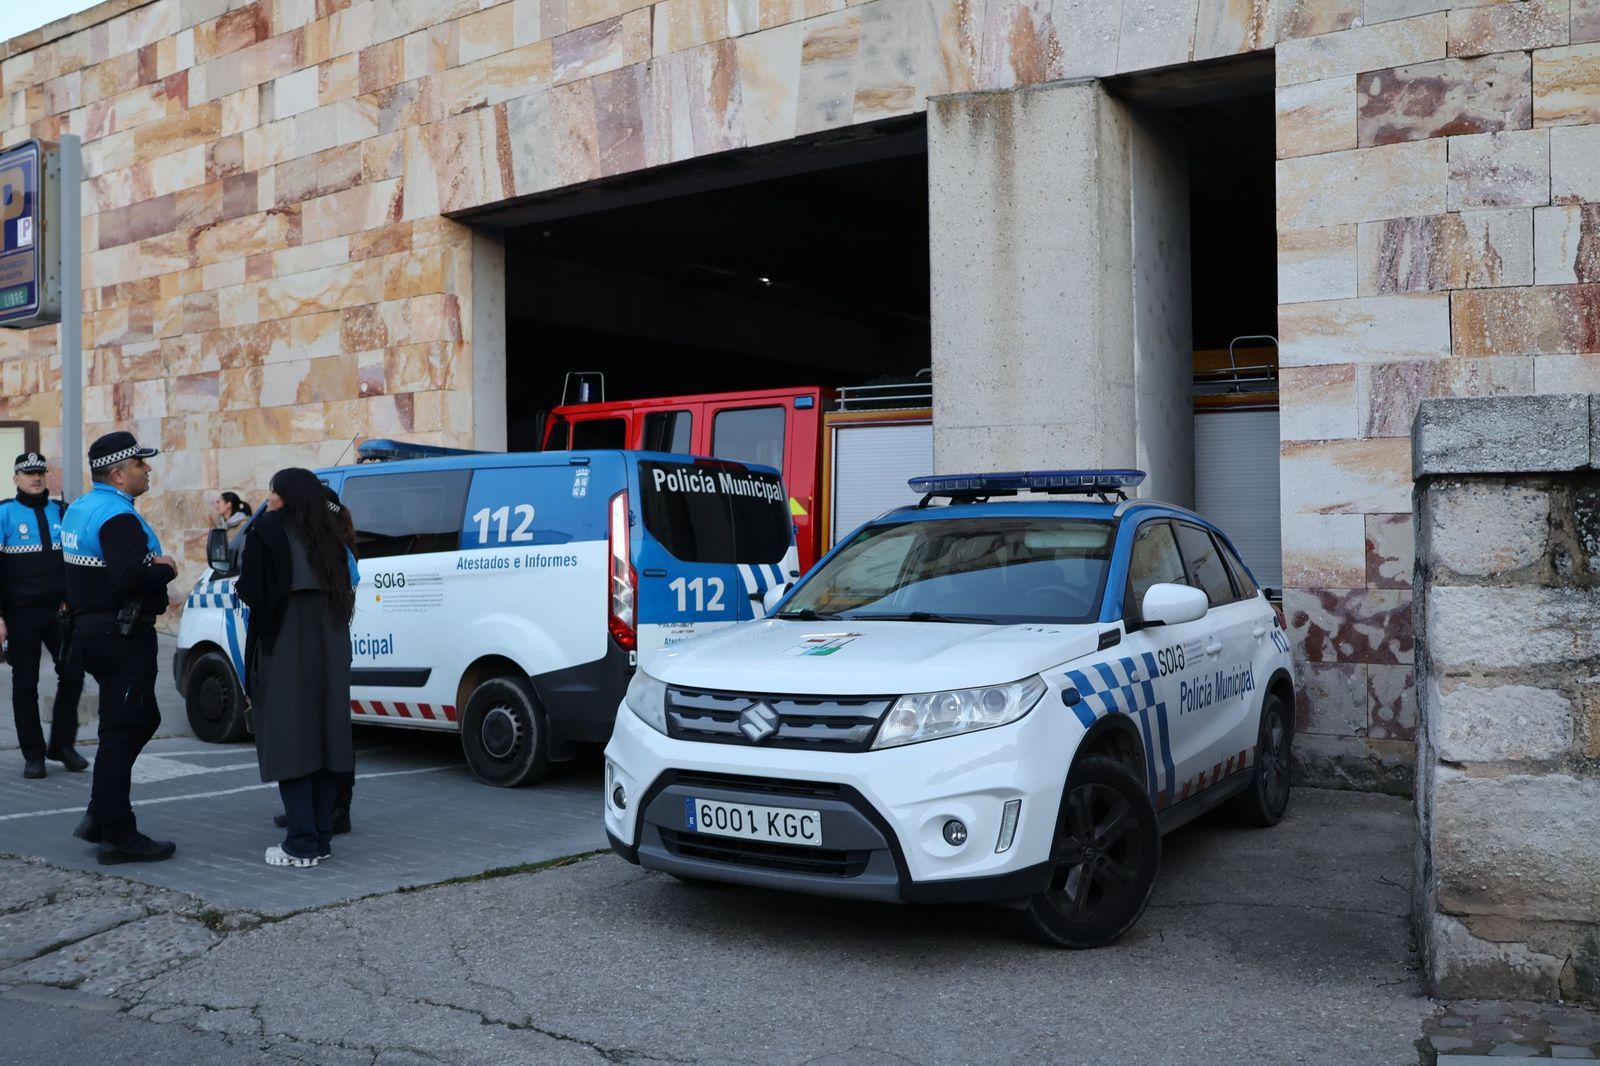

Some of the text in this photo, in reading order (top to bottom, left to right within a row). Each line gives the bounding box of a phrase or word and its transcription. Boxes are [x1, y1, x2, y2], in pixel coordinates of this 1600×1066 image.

[4, 290, 24, 307] LIBRE
[652, 468, 783, 504] Policía Municipal
[472, 504, 535, 544] 112
[457, 554, 577, 570] Atestados e Informes
[668, 577, 725, 612] 112
[351, 633, 393, 660] icipal
[1180, 661, 1255, 715] Policía Municipal
[701, 804, 815, 840] 6001 KGC
